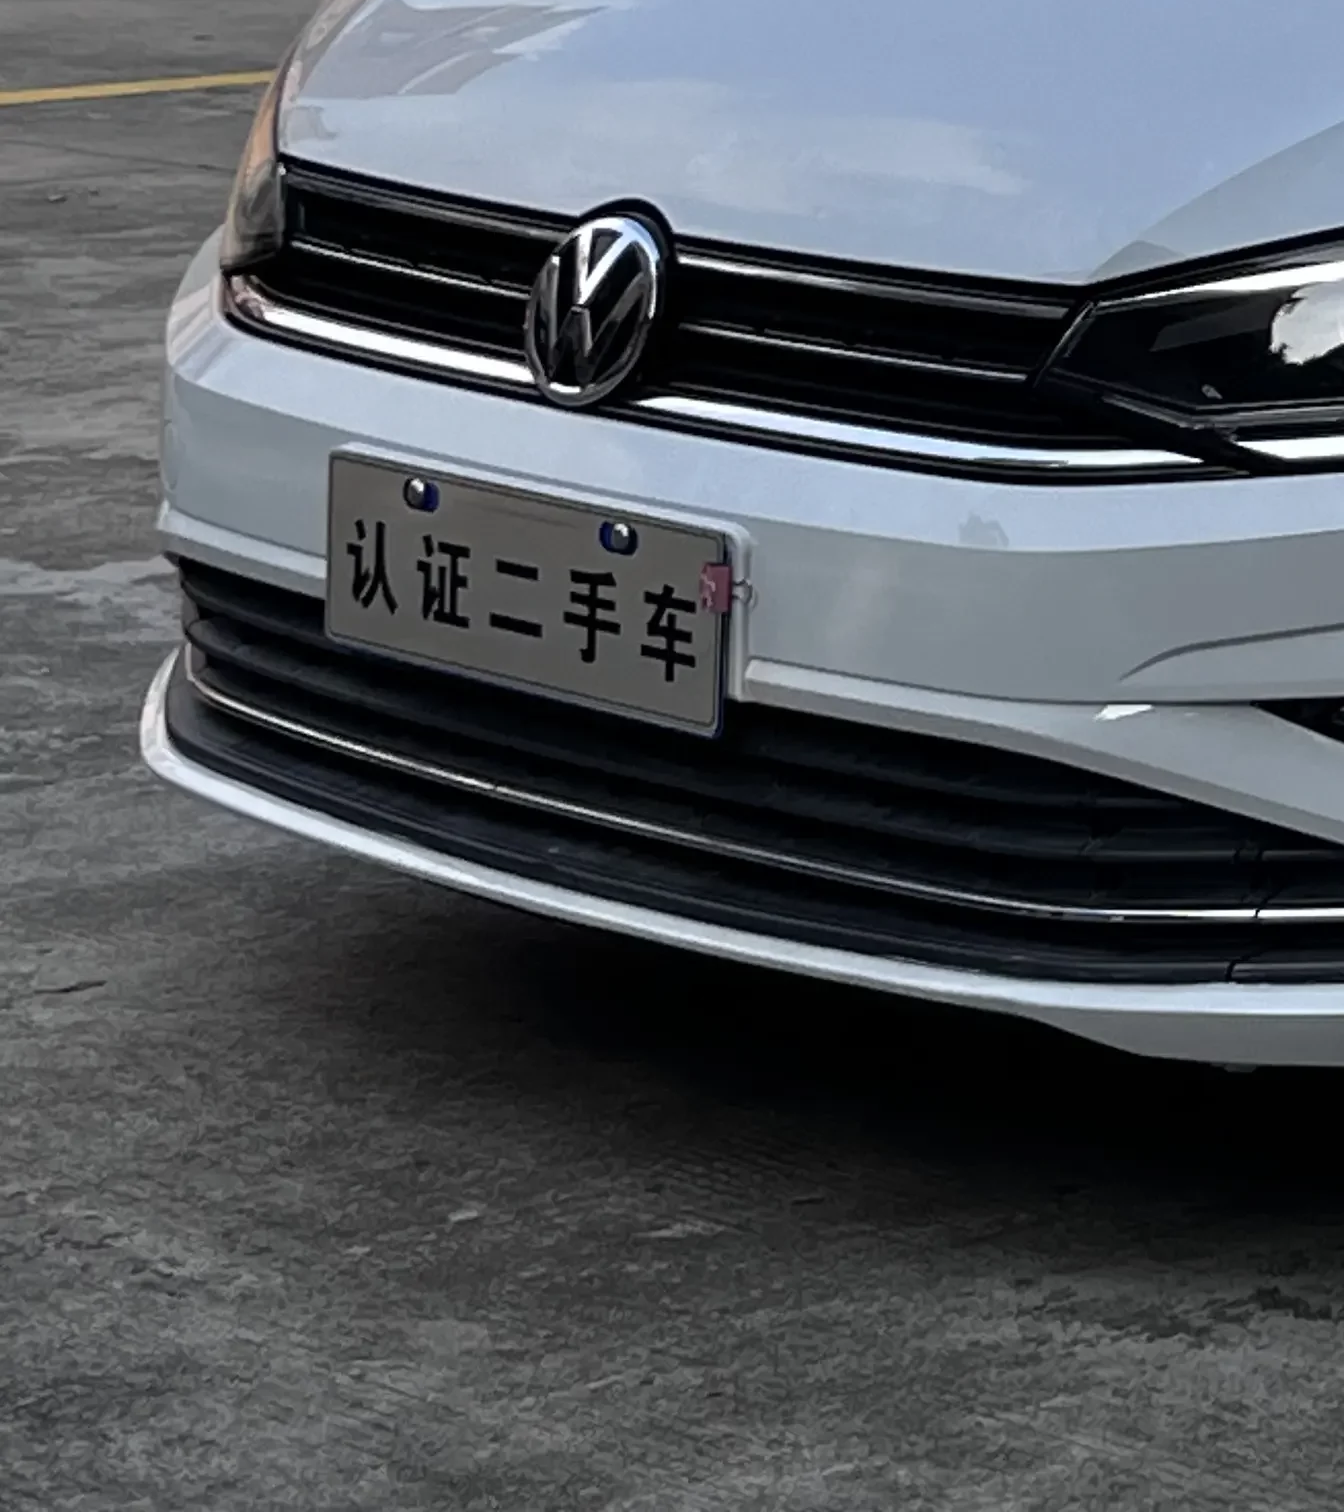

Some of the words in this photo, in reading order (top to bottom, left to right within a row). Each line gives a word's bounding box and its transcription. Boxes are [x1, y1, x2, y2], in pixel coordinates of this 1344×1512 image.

[346, 519, 697, 683] 认证二手车
